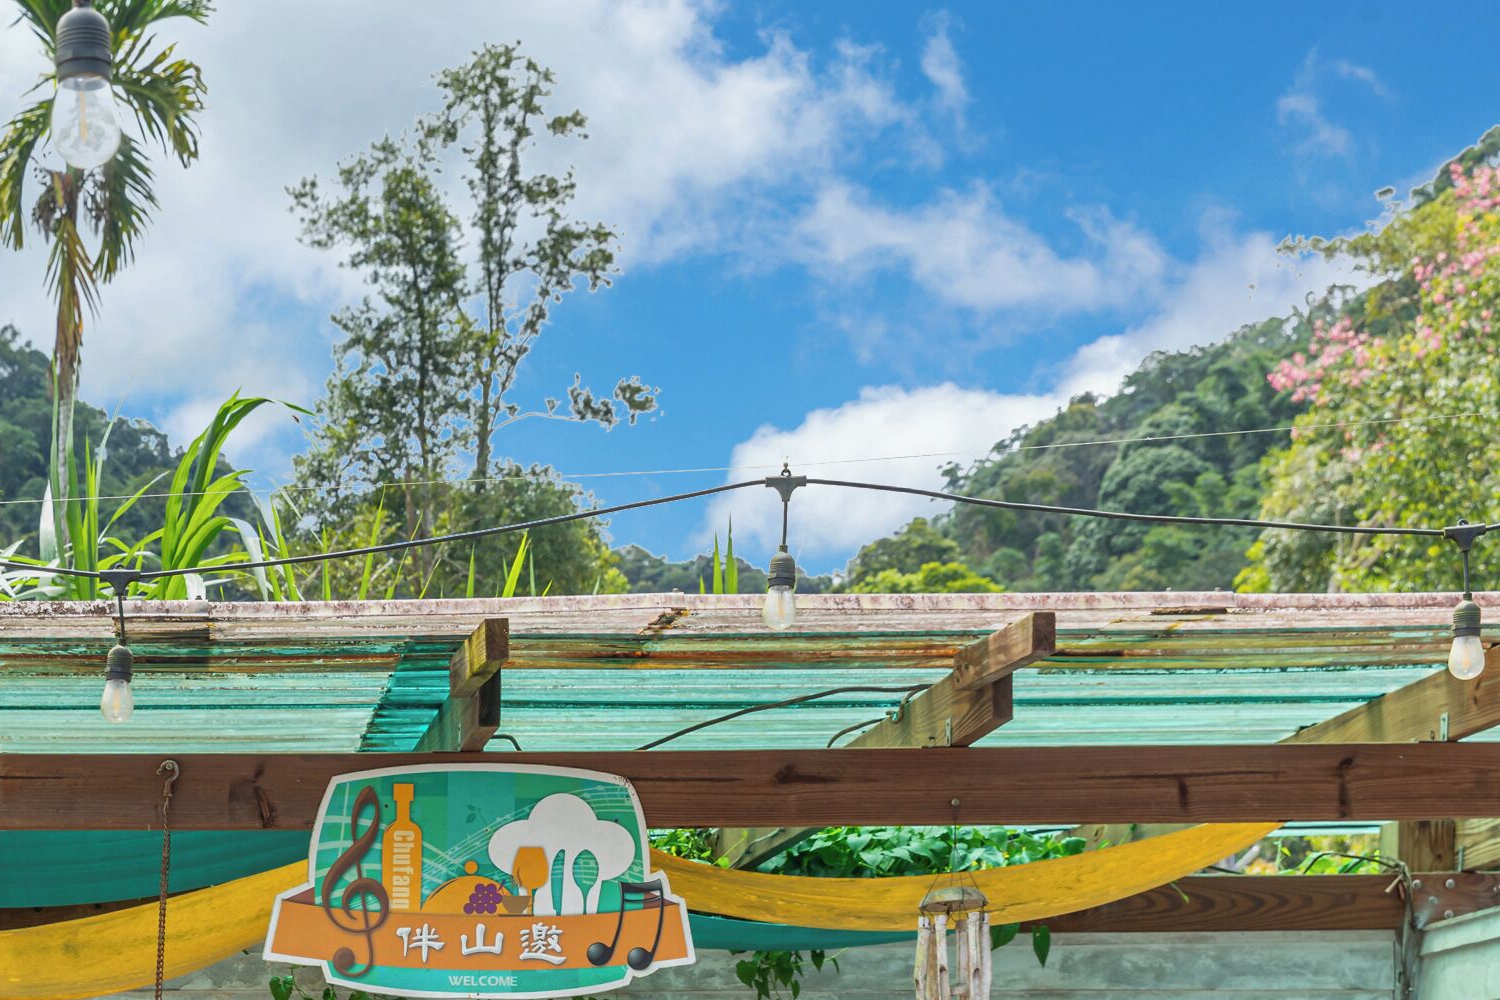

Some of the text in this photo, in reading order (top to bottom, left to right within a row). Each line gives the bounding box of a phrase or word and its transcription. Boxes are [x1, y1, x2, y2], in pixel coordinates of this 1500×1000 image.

[391, 830, 415, 909] Chufang
[396, 922, 567, 965] 伴山邀
[448, 975, 518, 987] WELCOME
